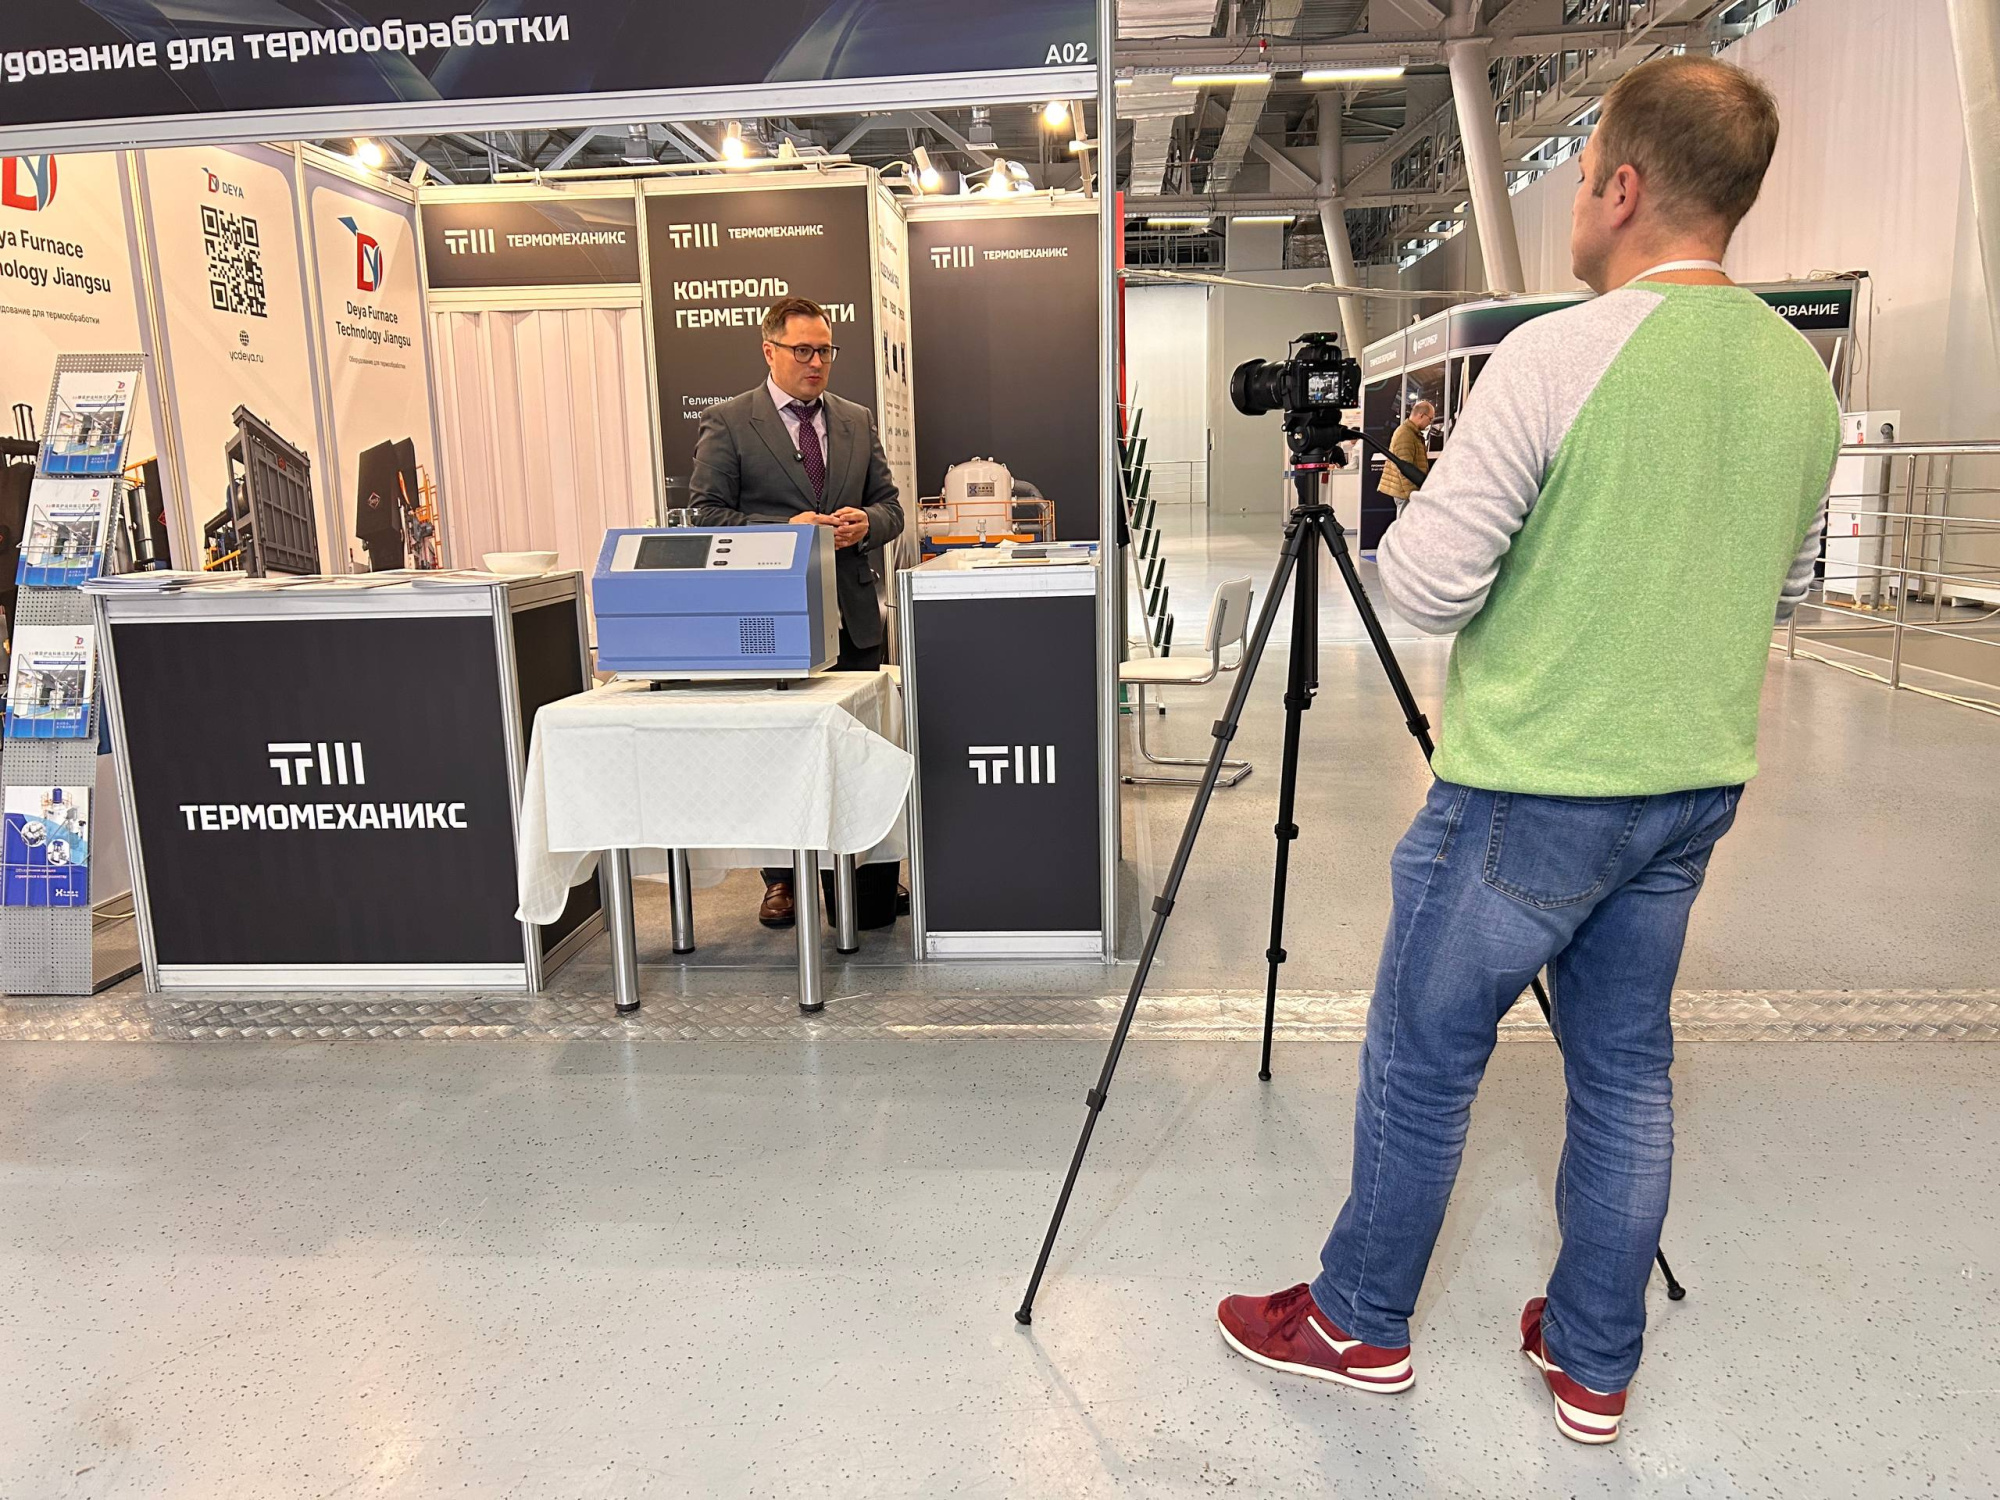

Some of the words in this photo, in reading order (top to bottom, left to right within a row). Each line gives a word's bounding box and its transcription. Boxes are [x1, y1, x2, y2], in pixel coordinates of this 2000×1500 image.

[0, 42, 157, 83] дование
[166, 36, 235, 70] для
[243, 14, 570, 63] термообработки
[1045, 42, 1088, 65] A02
[222, 181, 244, 199] DEYA
[506, 231, 626, 247] ТЕРМОМЕХАНИКС
[728, 224, 824, 239] ТЕРМОМЕХАНИКС
[20, 229, 84, 259] Furnace
[983, 247, 1068, 260] ТЕРМОМЕХАНИКС
[53, 266, 112, 295] Jiangsu
[673, 277, 789, 300] КОНТРОЛЬ
[0, 305, 31, 316] дование
[32, 308, 45, 318] для
[45, 310, 100, 325] термообработки
[346, 300, 367, 320] Deya
[368, 305, 398, 324] Furnace
[336, 320, 382, 345] Technology
[383, 329, 411, 349] Jiangsu
[180, 802, 467, 830] ТЕРМОМЕХАНИКС
